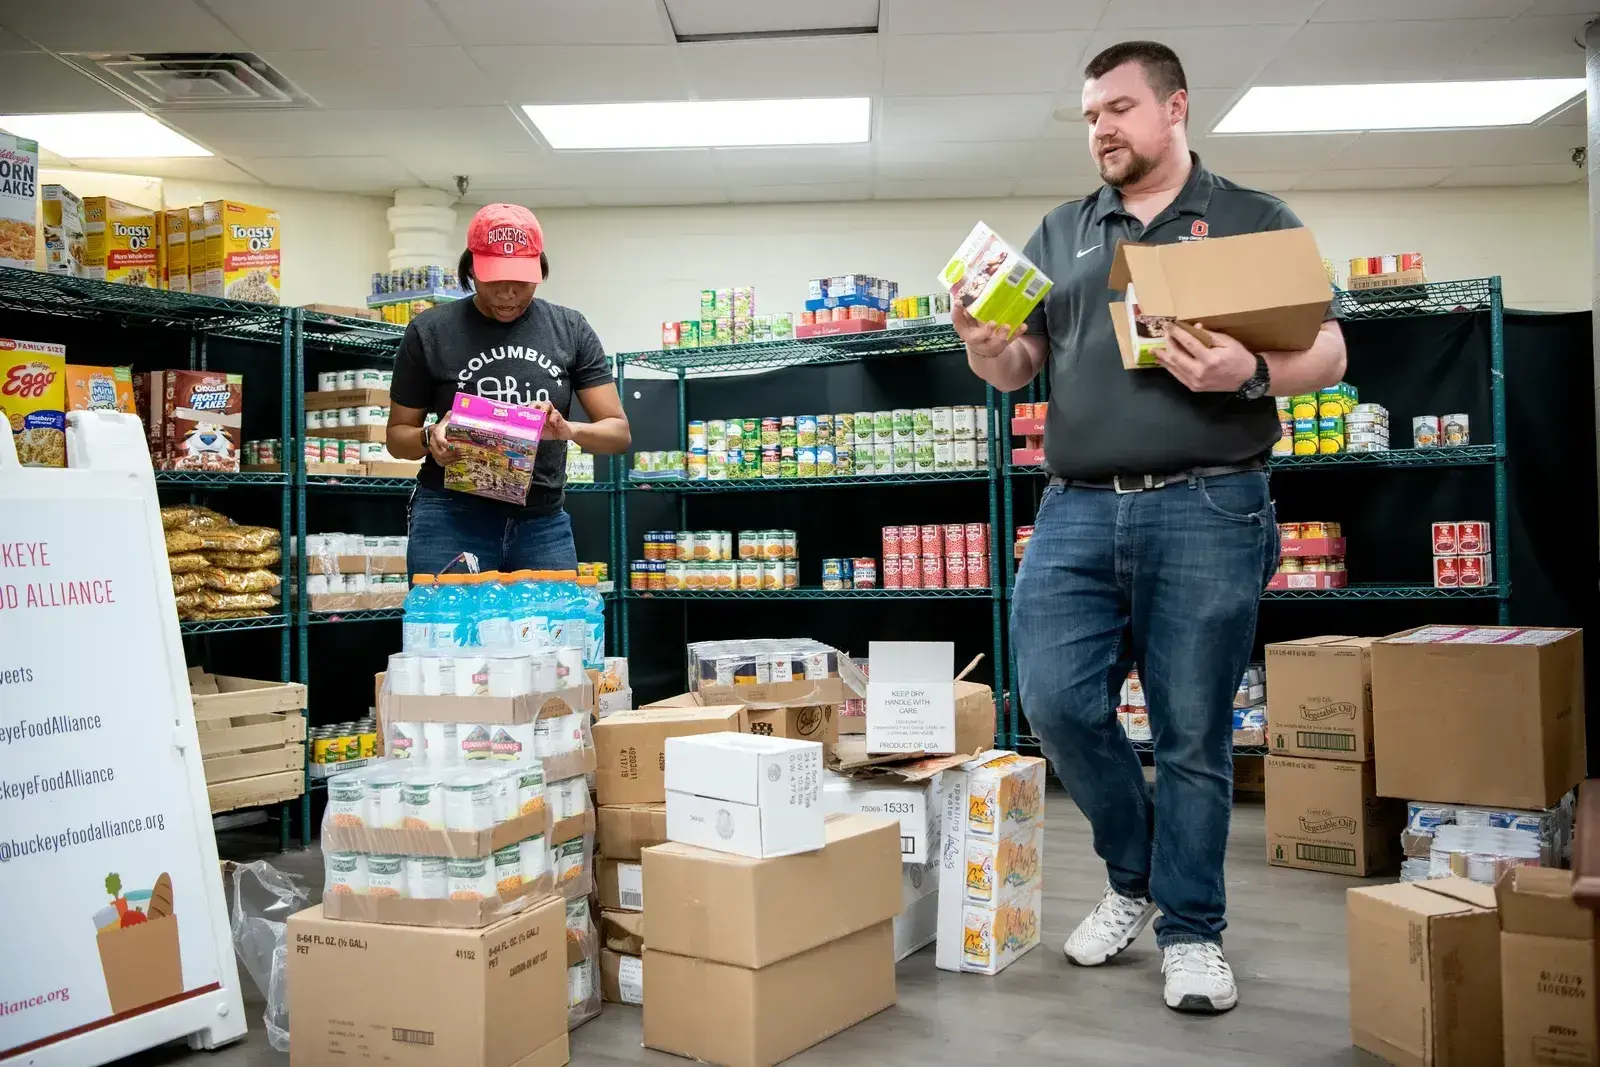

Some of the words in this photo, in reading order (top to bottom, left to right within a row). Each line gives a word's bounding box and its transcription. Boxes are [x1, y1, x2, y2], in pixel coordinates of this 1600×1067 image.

[0, 179, 35, 197] AKES
[112, 222, 152, 240] Toasty
[230, 225, 275, 240] Toasty
[488, 227, 527, 246] BUCKEYES
[129, 236, 147, 250] O's
[248, 237, 270, 252] O's
[18, 342, 44, 351] FAMILY
[458, 345, 561, 381] COLUMBUS
[2, 365, 57, 398] Eggo
[93, 386, 113, 395] Mini
[190, 392, 231, 402] FROSTED
[476, 375, 551, 405] Ohio
[192, 400, 227, 410] FLAKES
[27, 580, 115, 608] ALLIANCE
[1303, 705, 1338, 720] Vegetable
[1338, 704, 1352, 713] Oil
[620, 749, 629, 778] 4/17/19
[804, 752, 810, 762] 24
[812, 752, 817, 761] 24
[953, 783, 961, 832] sparkling
[1303, 820, 1338, 833] Vegetable
[1338, 818, 1352, 828] Oil
[0, 813, 165, 862] @buckeyefoodalliance.org
[296, 933, 312, 943] 8-64
[313, 935, 324, 945] FL.
[325, 936, 337, 947] OZ.
[348, 938, 368, 951] GAL.)
[488, 944, 501, 957] 8-64
[501, 940, 509, 951] FL.
[509, 937, 518, 948] OZ.
[525, 926, 540, 941] GAL.)
[296, 945, 309, 955] PET
[455, 948, 476, 960] 41152
[488, 957, 499, 969] PET
[532, 954, 540, 967] NOT
[540, 950, 548, 964] CUT
